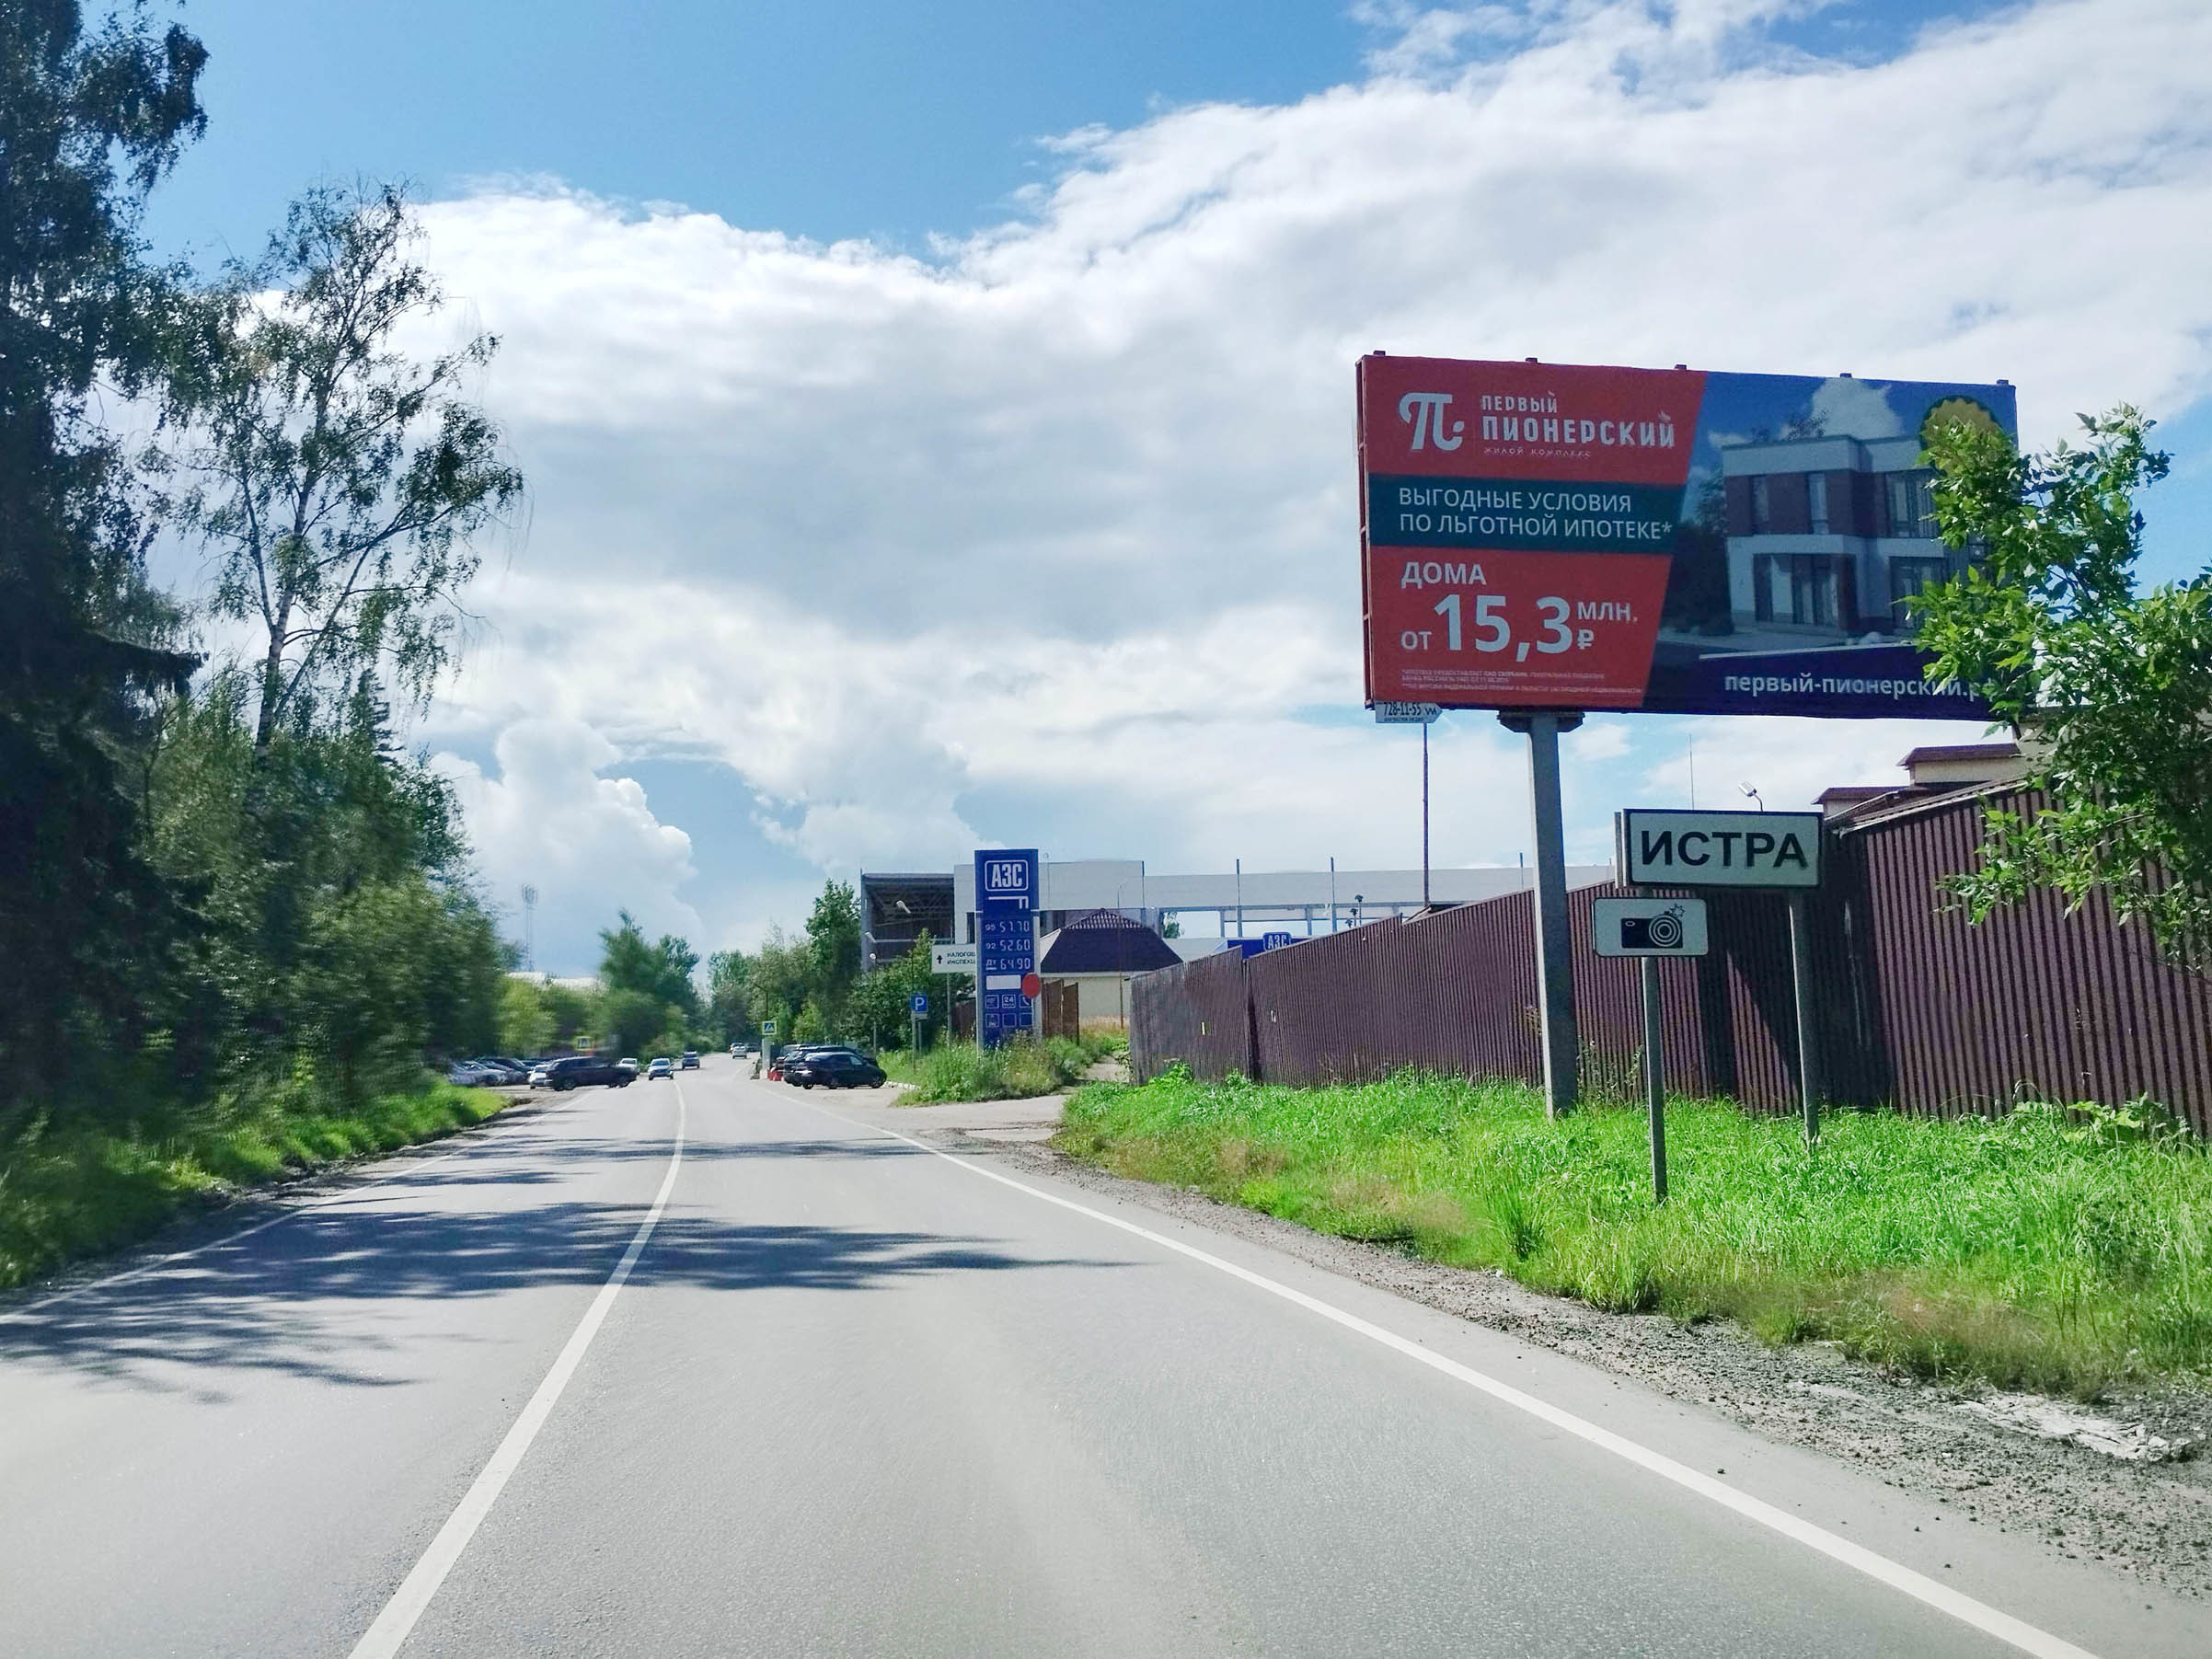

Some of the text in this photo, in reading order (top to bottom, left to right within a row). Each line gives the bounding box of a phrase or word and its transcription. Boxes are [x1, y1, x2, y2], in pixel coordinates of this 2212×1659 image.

[1481, 390, 1558, 413] ПЕРВЫЙ
[1482, 410, 1675, 448] ПИОНЕРСКИЙ
[1399, 488, 1631, 513] ВЫГОДНЫЕ УСЛОВИЯ
[1400, 514, 1432, 533] ПО
[1438, 513, 1558, 537] ЛЬГОТНОЙ
[1400, 561, 1487, 589] ДОМА
[1400, 630, 1432, 651] ОТ
[1434, 594, 1573, 662] 15,3
[1641, 830, 1809, 870] ИСТРА
[991, 863, 1022, 888] АЗС
[1268, 935, 1287, 950] АЗС
